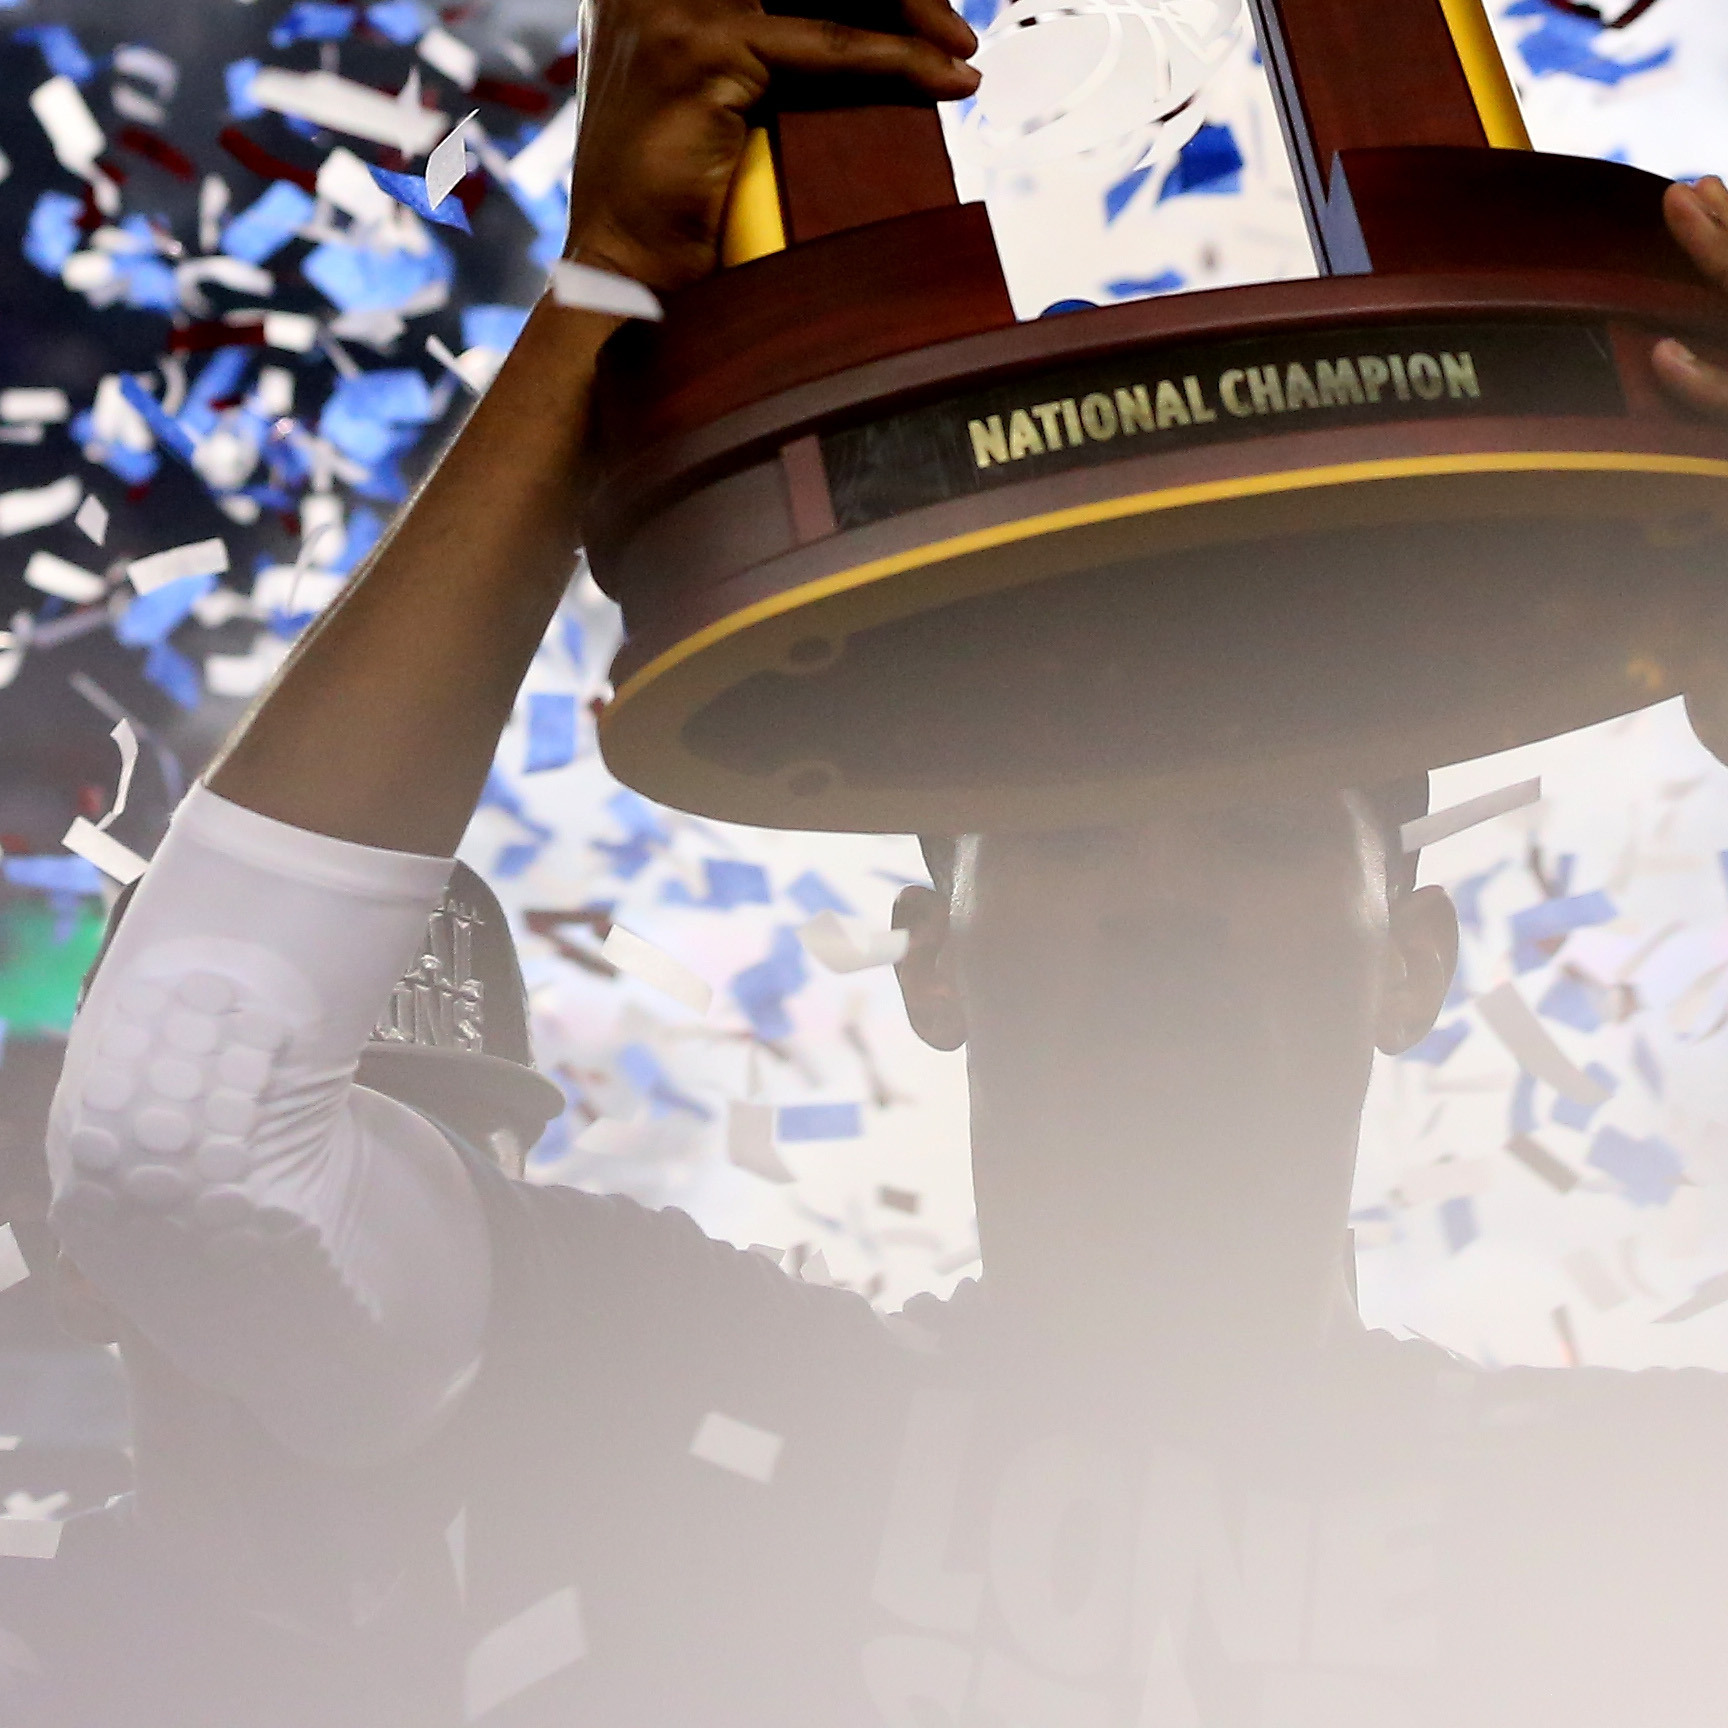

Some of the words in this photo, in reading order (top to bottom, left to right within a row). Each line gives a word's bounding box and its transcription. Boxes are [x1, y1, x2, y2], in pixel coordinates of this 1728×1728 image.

[967, 374, 1217, 470] NATIONAL
[1218, 351, 1481, 419] CHAMPION
[873, 1389, 1442, 1676] LONE
